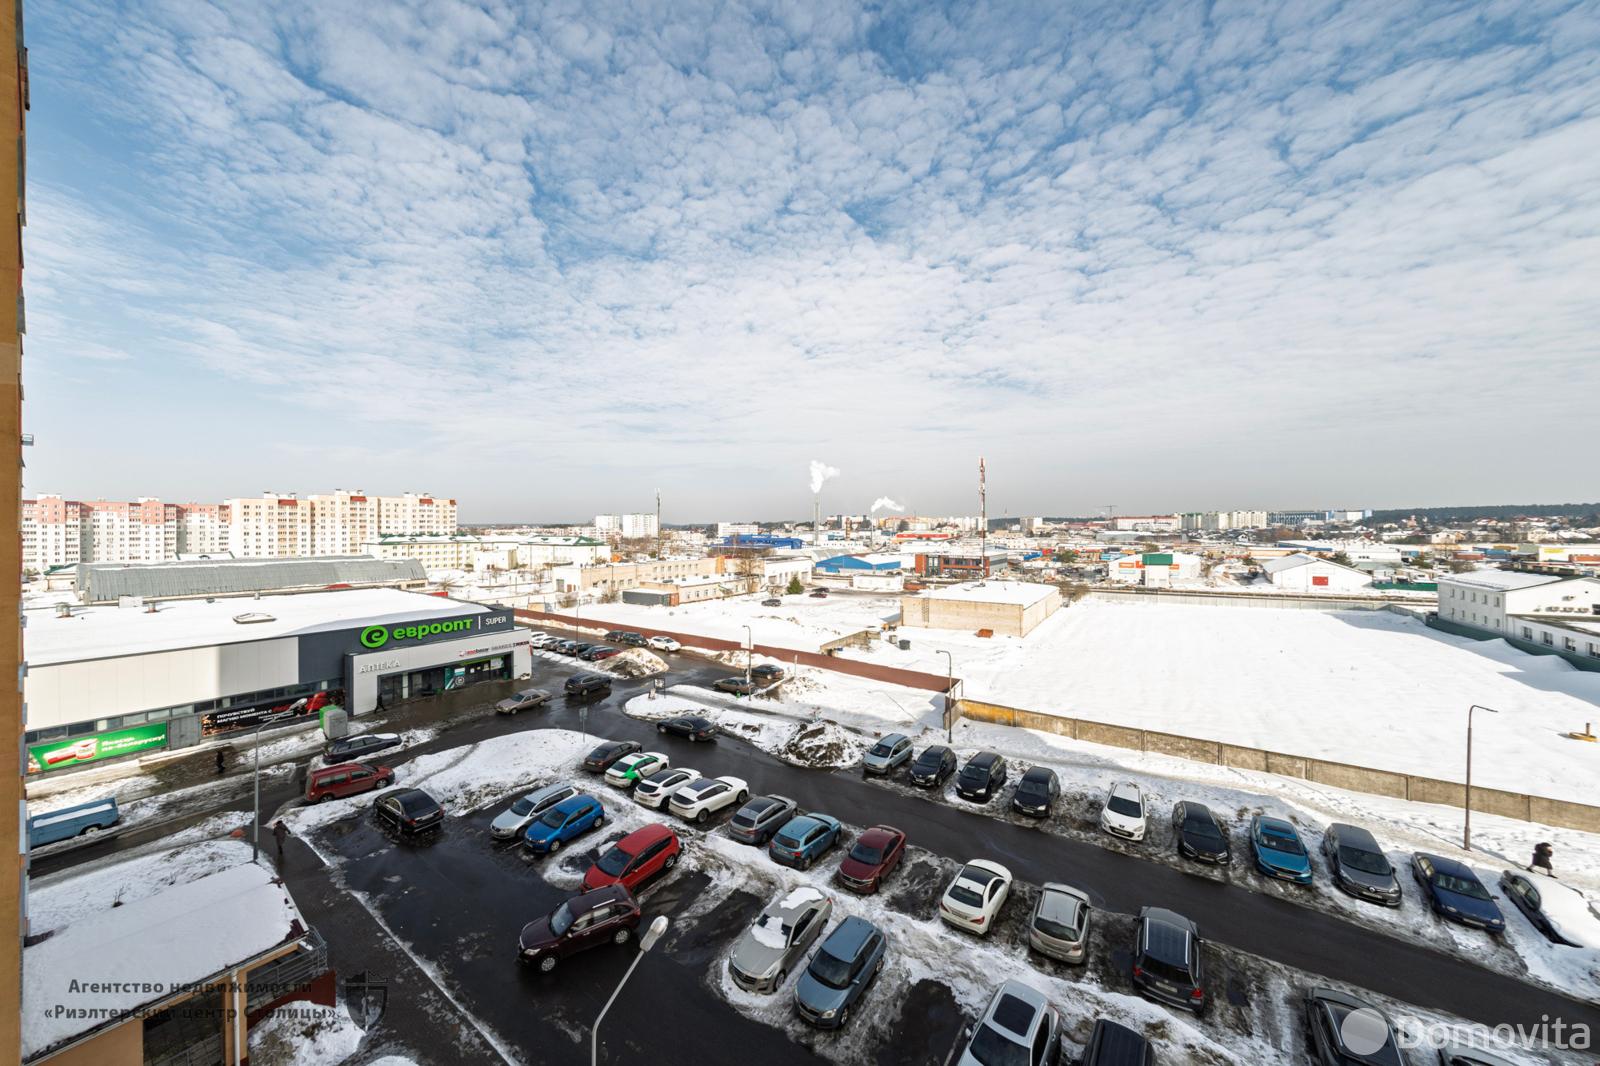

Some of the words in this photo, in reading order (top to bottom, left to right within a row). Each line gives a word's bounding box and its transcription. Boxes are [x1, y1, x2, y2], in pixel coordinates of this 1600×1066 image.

[485, 615, 507, 626] SUPER
[393, 618, 474, 640] евроопт
[358, 658, 401, 674] АПТЕКА
